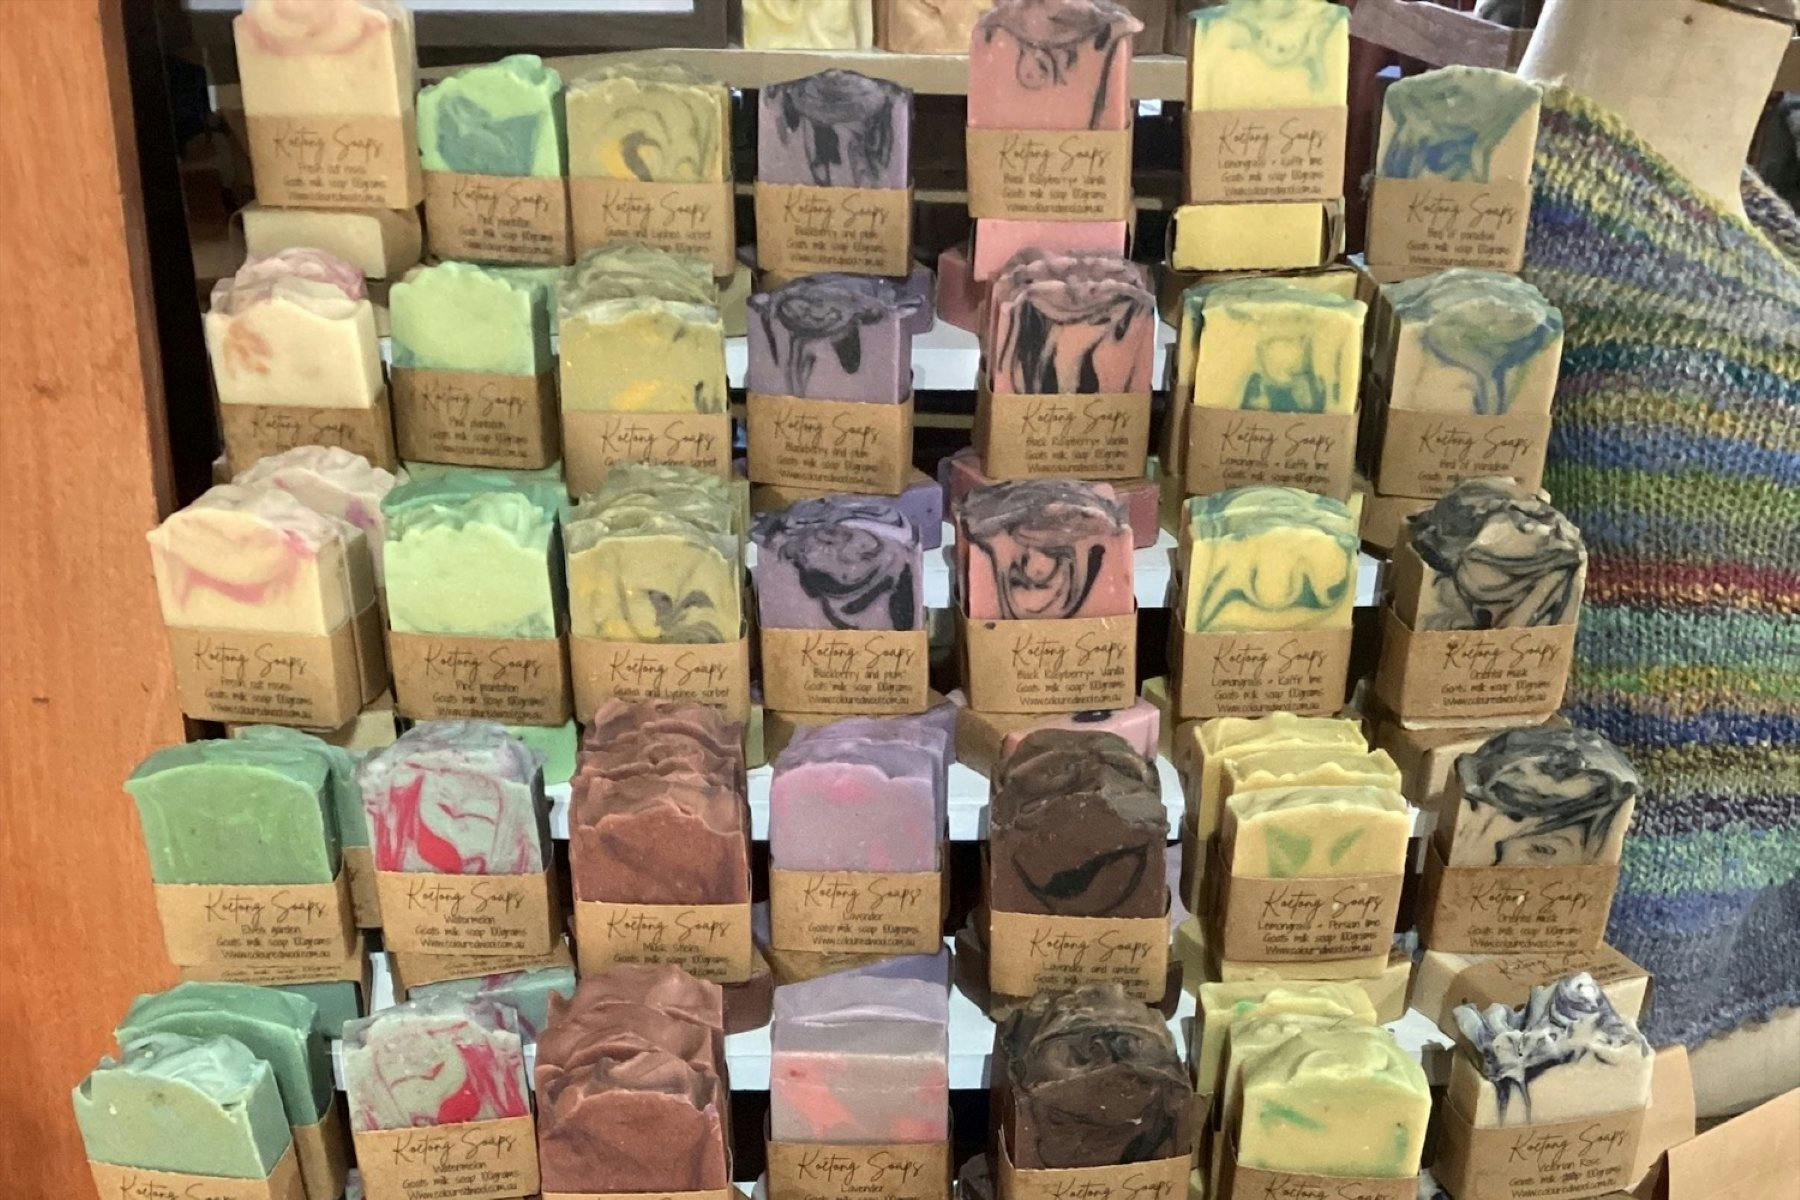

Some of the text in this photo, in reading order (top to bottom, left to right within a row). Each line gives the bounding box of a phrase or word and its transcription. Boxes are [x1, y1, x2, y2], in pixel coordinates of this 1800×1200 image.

[193, 643, 306, 680] Koetong Soaps
[425, 645, 540, 680] Koetong Soaps
[801, 630, 914, 667] Koetong Soaps
[1012, 634, 1127, 671] Koetong Soaps
[1213, 640, 1327, 677] Koetong Soaps
[1442, 634, 1561, 675] Koetong Soaps
[610, 650, 727, 684] Koetong Soaps
[645, 688, 660, 696] and
[204, 890, 326, 926] Koetong Soaps
[406, 882, 525, 914] Koetong Soaps
[803, 878, 921, 912] Koetong Soaps
[1263, 886, 1382, 920] Koetong Soaps
[1470, 881, 1587, 915] Koetong Soaps
[607, 911, 731, 941] Koetong Soaps
[1030, 929, 1152, 963] Koetong Soaps
[392, 1126, 518, 1163] Koetong Soaps
[1510, 1123, 1628, 1169] Koetong Soaps
[798, 1153, 923, 1187] Koetong Soaps
[841, 1184, 884, 1192] Lavender
